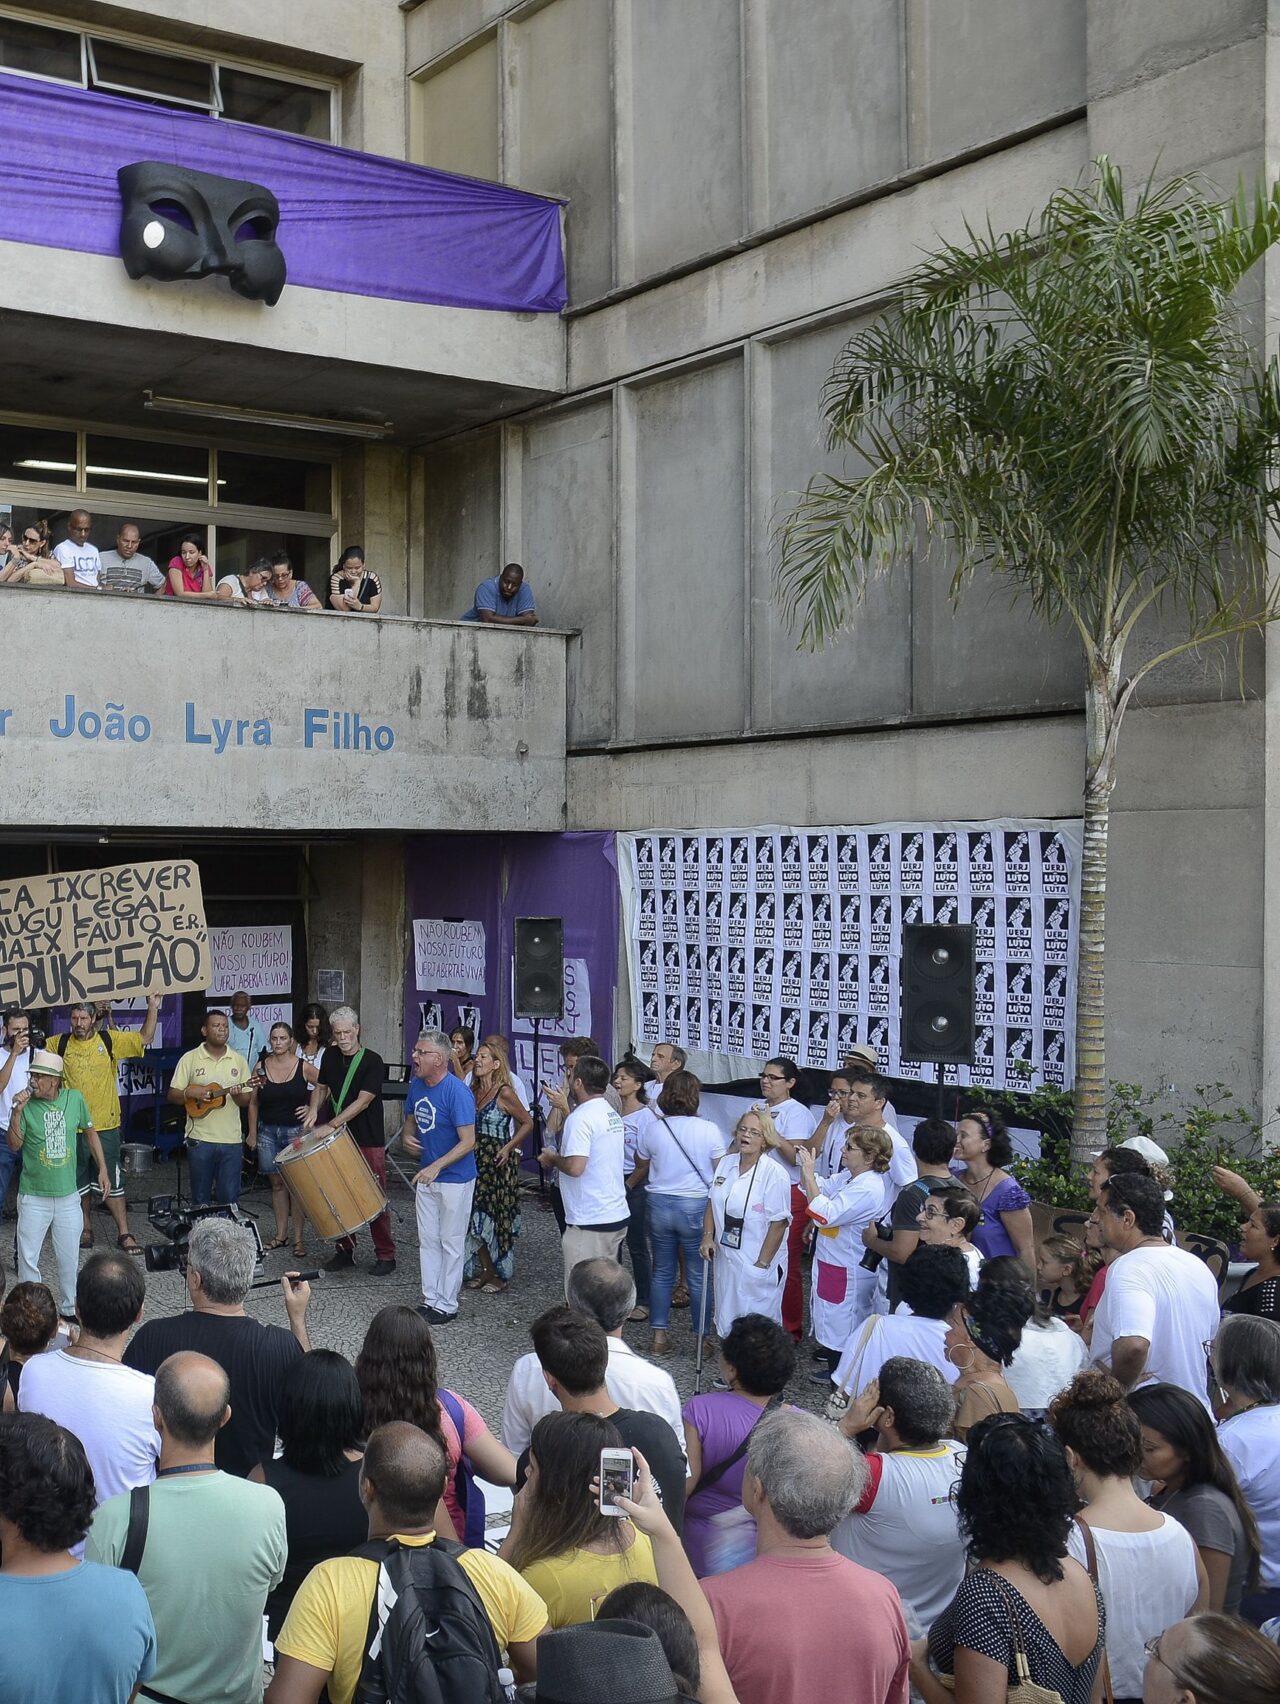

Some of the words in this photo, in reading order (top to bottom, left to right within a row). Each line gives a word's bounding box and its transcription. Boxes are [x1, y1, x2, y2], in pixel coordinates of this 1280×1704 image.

[51, 695, 151, 743] João
[186, 703, 272, 754] Lyra
[304, 709, 395, 751] Filho
[47, 864, 191, 904] IXCREVER
[936, 873, 956, 881] LUTO
[971, 873, 992, 881] LUTO
[1007, 874, 1028, 882] LUTO
[1044, 874, 1066, 882] LUTO
[1008, 884, 1028, 892] LUTA
[72, 892, 185, 927] LEGAL,
[74, 914, 162, 948] FAUTO
[173, 914, 204, 930] E.R.
[420, 922, 442, 939] NÃO
[444, 924, 482, 942] ROUBEM
[212, 930, 234, 950] NÃO
[241, 931, 283, 948] ROUBEM
[1008, 939, 1029, 947] LUTO
[1047, 941, 1066, 949] LUTO
[418, 942, 448, 956] NOSSO
[449, 944, 483, 960] FUTURO
[1008, 950, 1029, 958] LUTA
[213, 954, 246, 972] NOSSO
[252, 951, 289, 971] FUTURO!
[417, 961, 436, 976] UERJ
[436, 962, 460, 978] ABERTA
[461, 963, 464, 978] E
[214, 973, 236, 992] UERJ
[238, 972, 263, 990] ABERTA
[264, 972, 269, 986] E
[270, 972, 288, 987] VIVA
[250, 1007, 283, 1022] PRECISA
[1008, 1005, 1030, 1013] LUTO
[1045, 1008, 1063, 1016] LUTO
